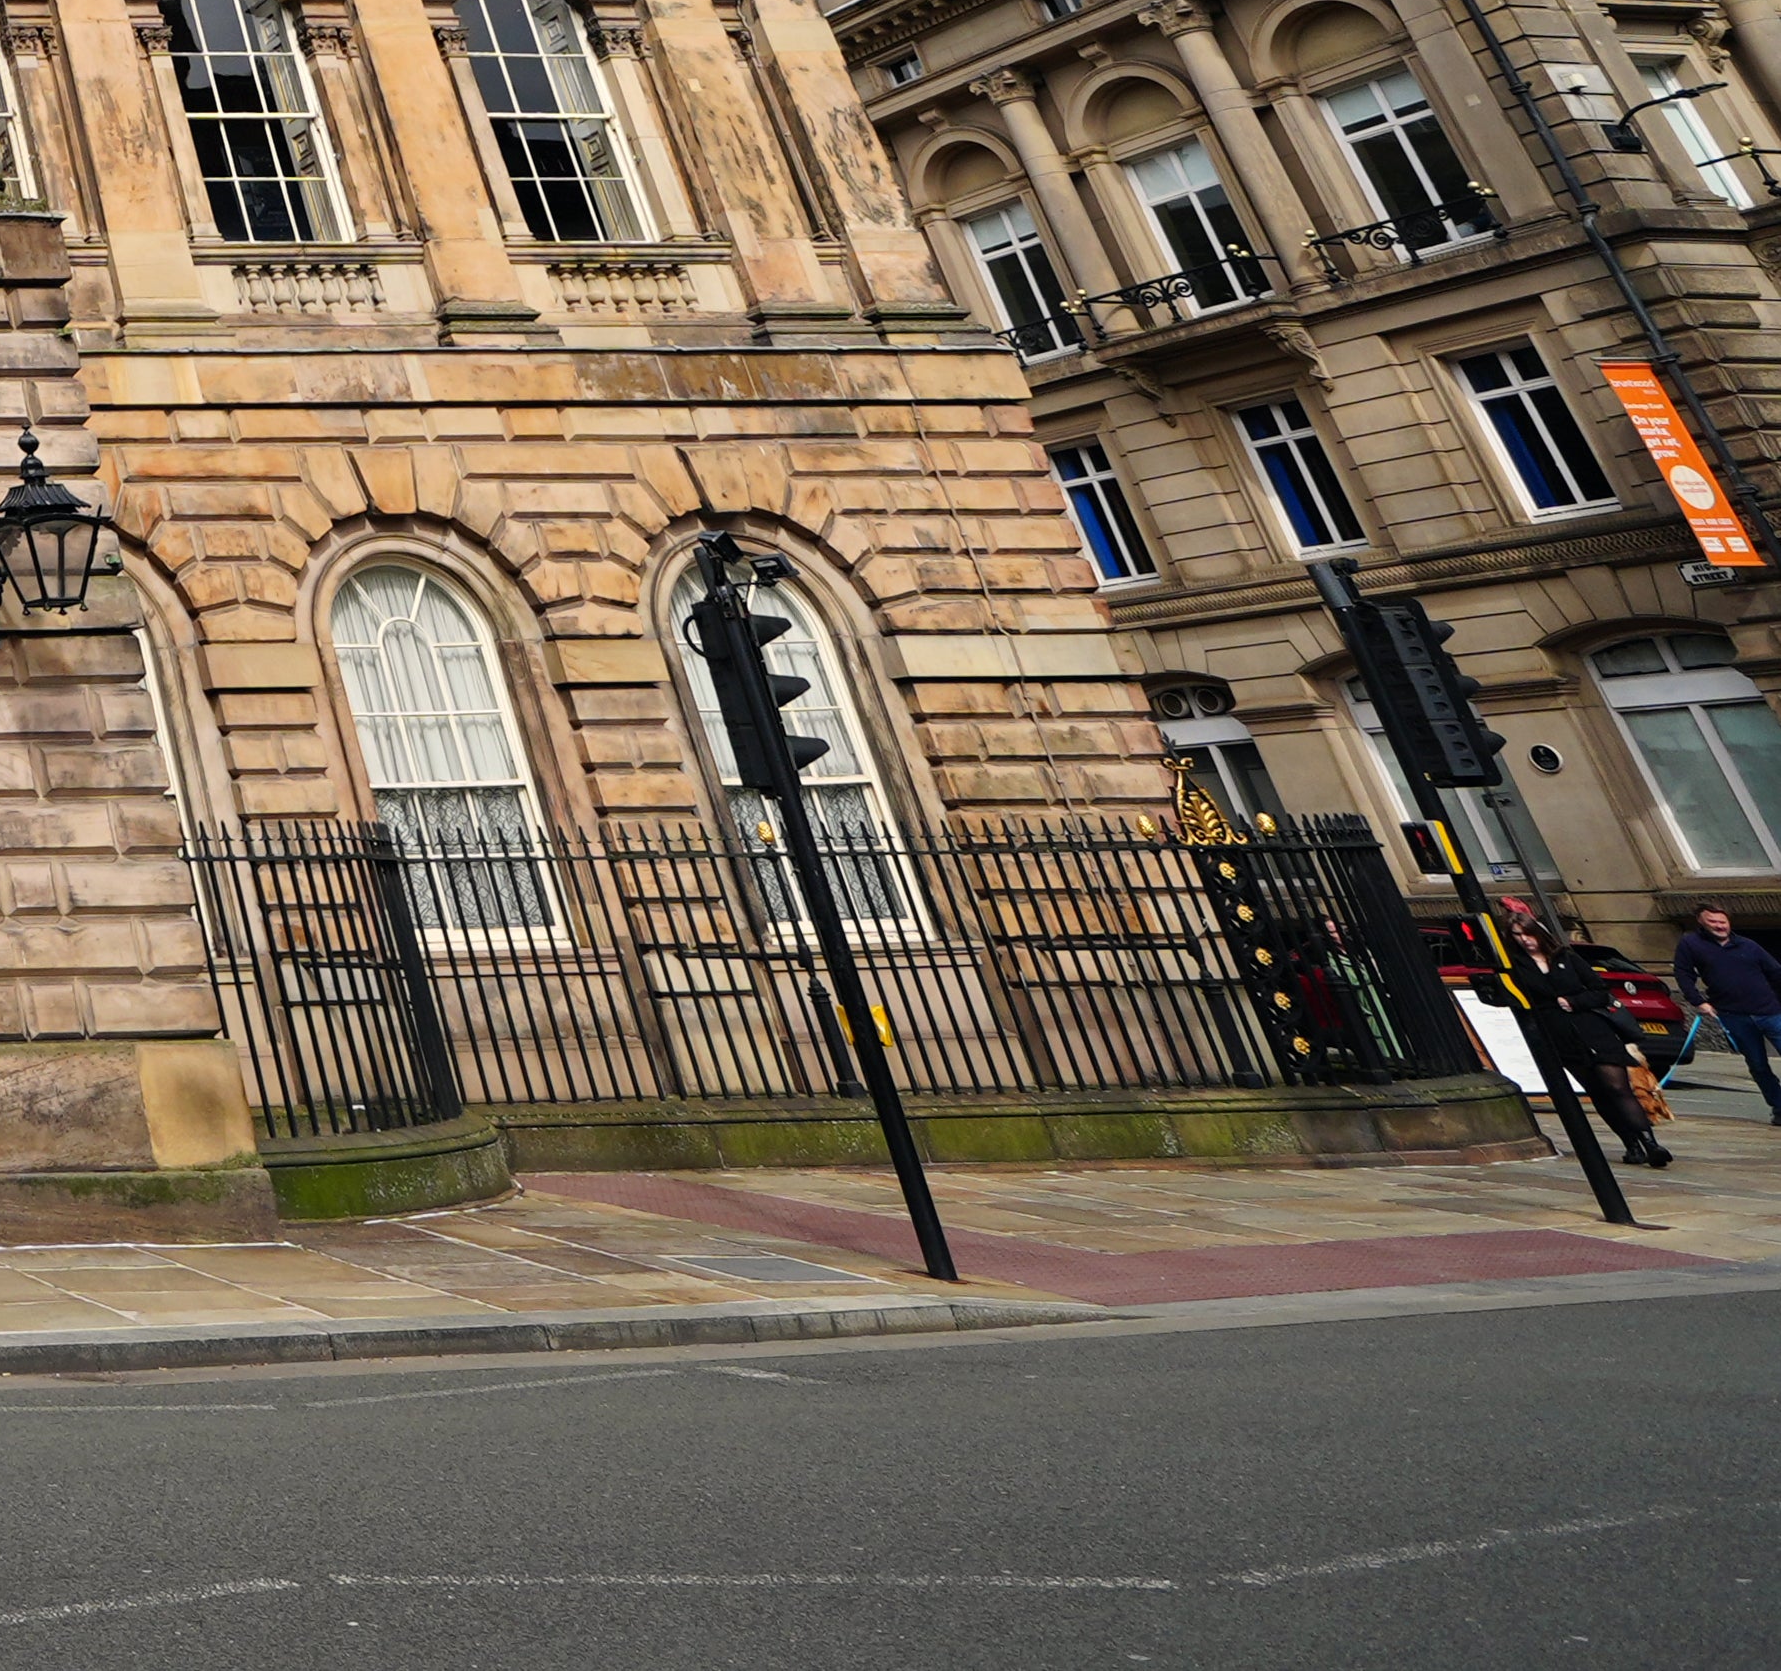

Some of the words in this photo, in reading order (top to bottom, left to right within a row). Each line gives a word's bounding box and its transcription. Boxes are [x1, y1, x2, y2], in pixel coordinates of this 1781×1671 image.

[1631, 415, 1648, 425] On
[1648, 417, 1670, 427] your
[1645, 437, 1663, 448] get
[1691, 571, 1729, 583] STREET
